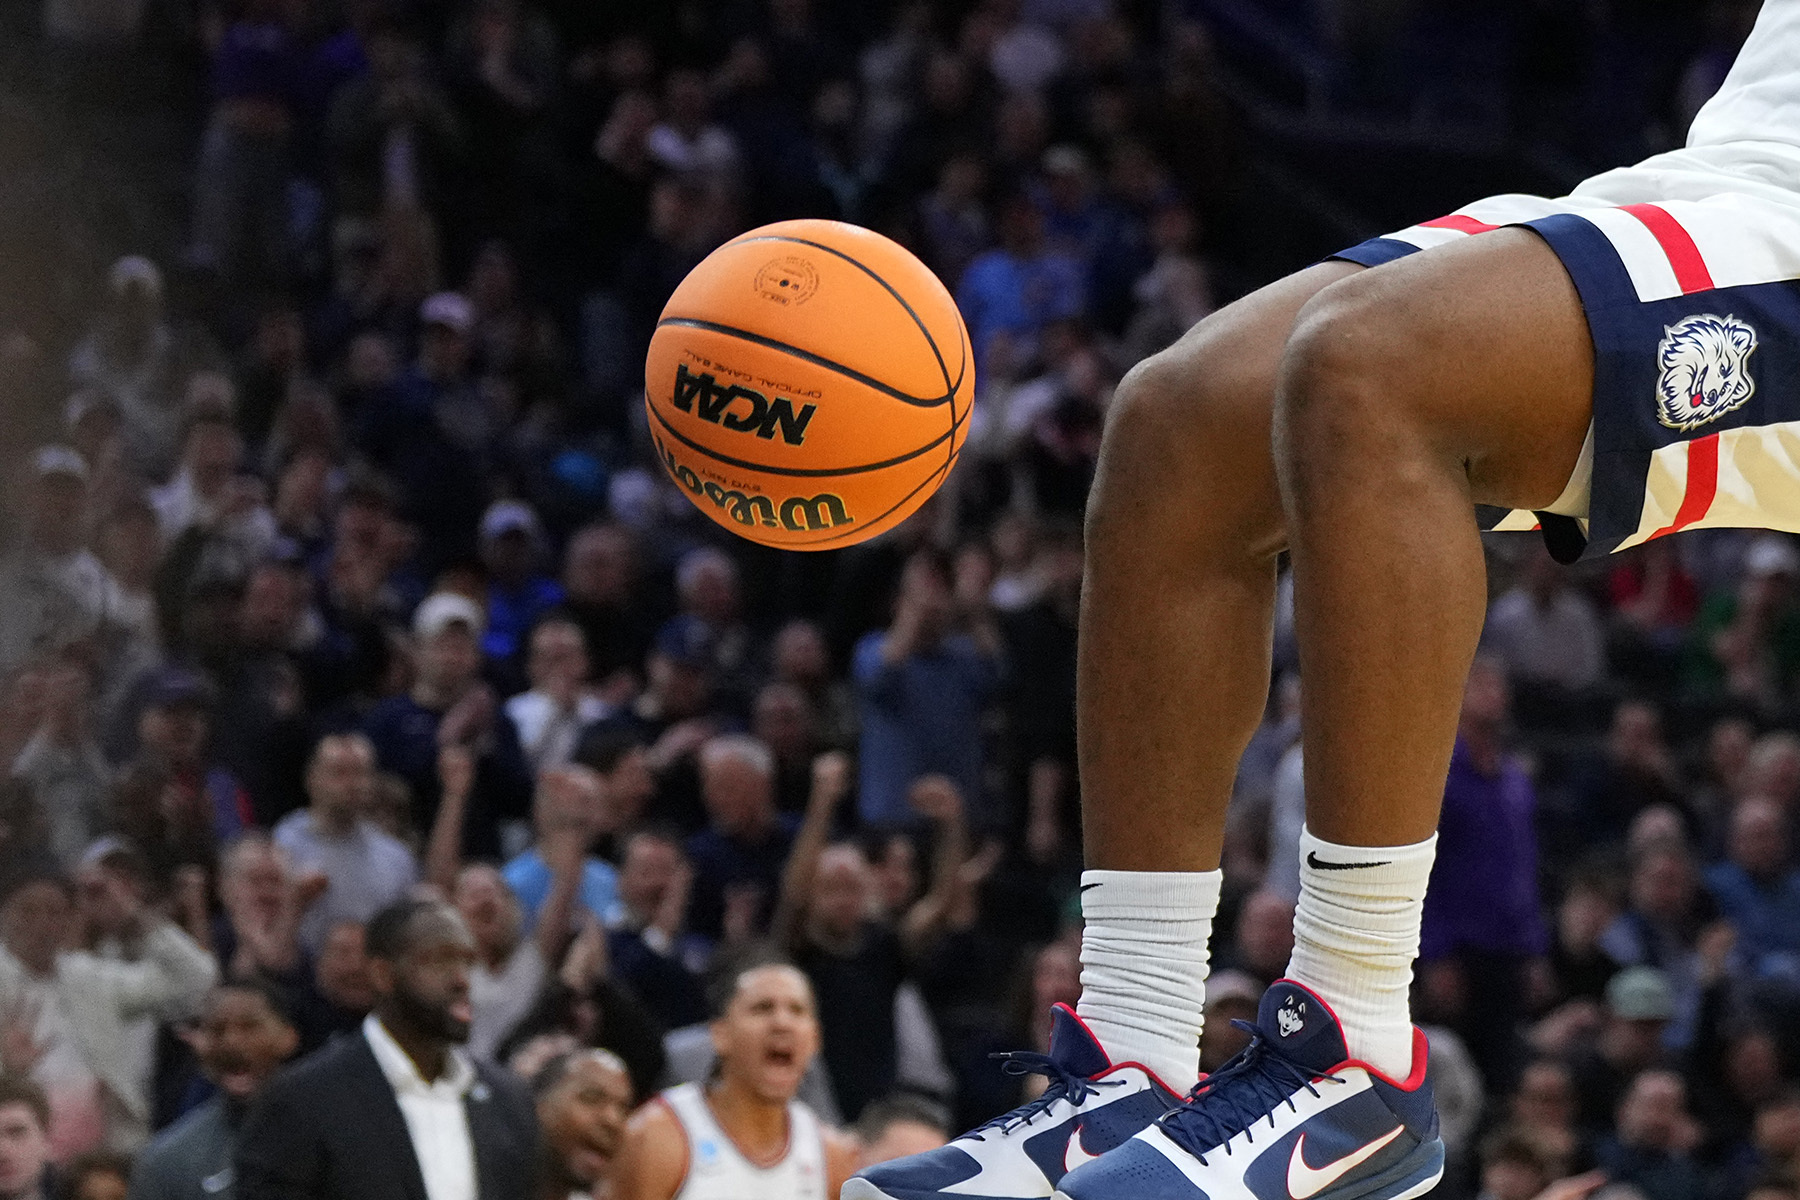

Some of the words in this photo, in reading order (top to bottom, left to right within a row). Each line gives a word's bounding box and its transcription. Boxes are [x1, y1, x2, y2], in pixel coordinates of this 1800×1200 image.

[684, 348, 711, 367] BALL
[713, 362, 753, 382] GAME
[757, 377, 822, 399] OFFICIAL
[673, 363, 817, 446] NCAA
[656, 434, 856, 532] Wilson
